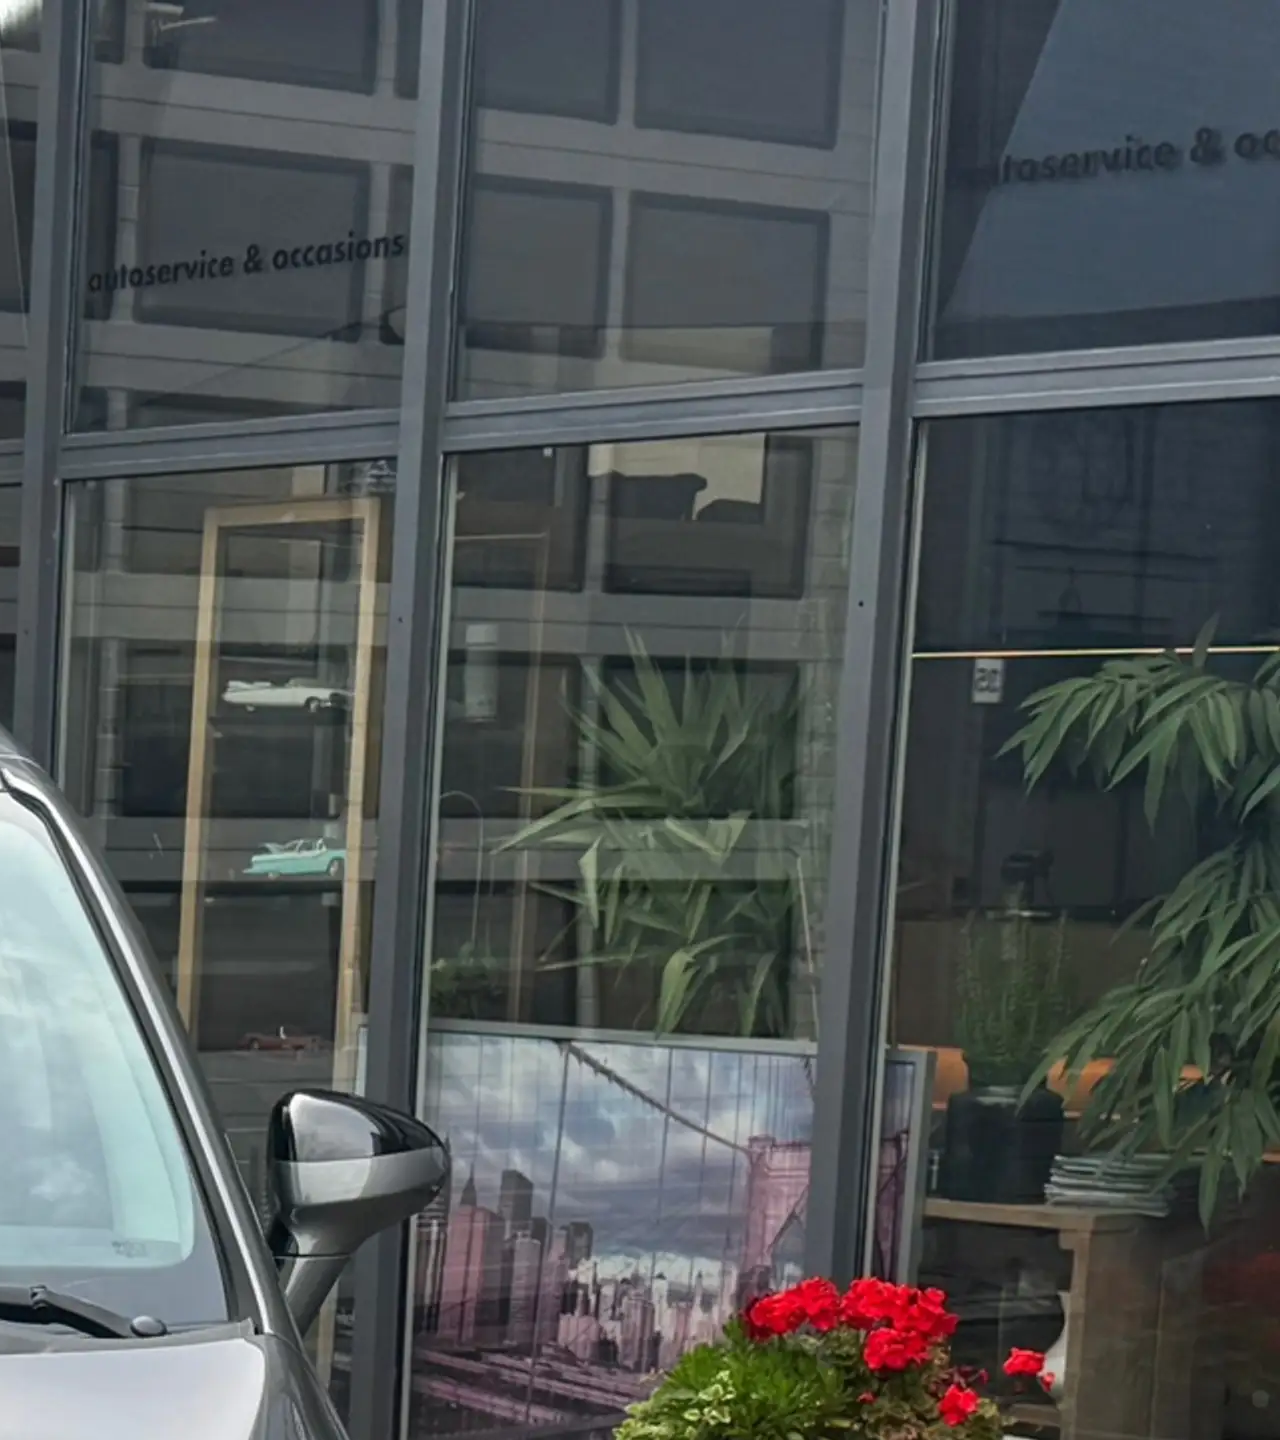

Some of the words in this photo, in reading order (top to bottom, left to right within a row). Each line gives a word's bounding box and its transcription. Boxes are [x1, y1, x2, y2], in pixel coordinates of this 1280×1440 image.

[954, 134, 1176, 187] toservice
[1190, 126, 1224, 166] &
[89, 250, 233, 293] autoservice
[243, 243, 263, 274] &
[272, 231, 405, 271] occasions
